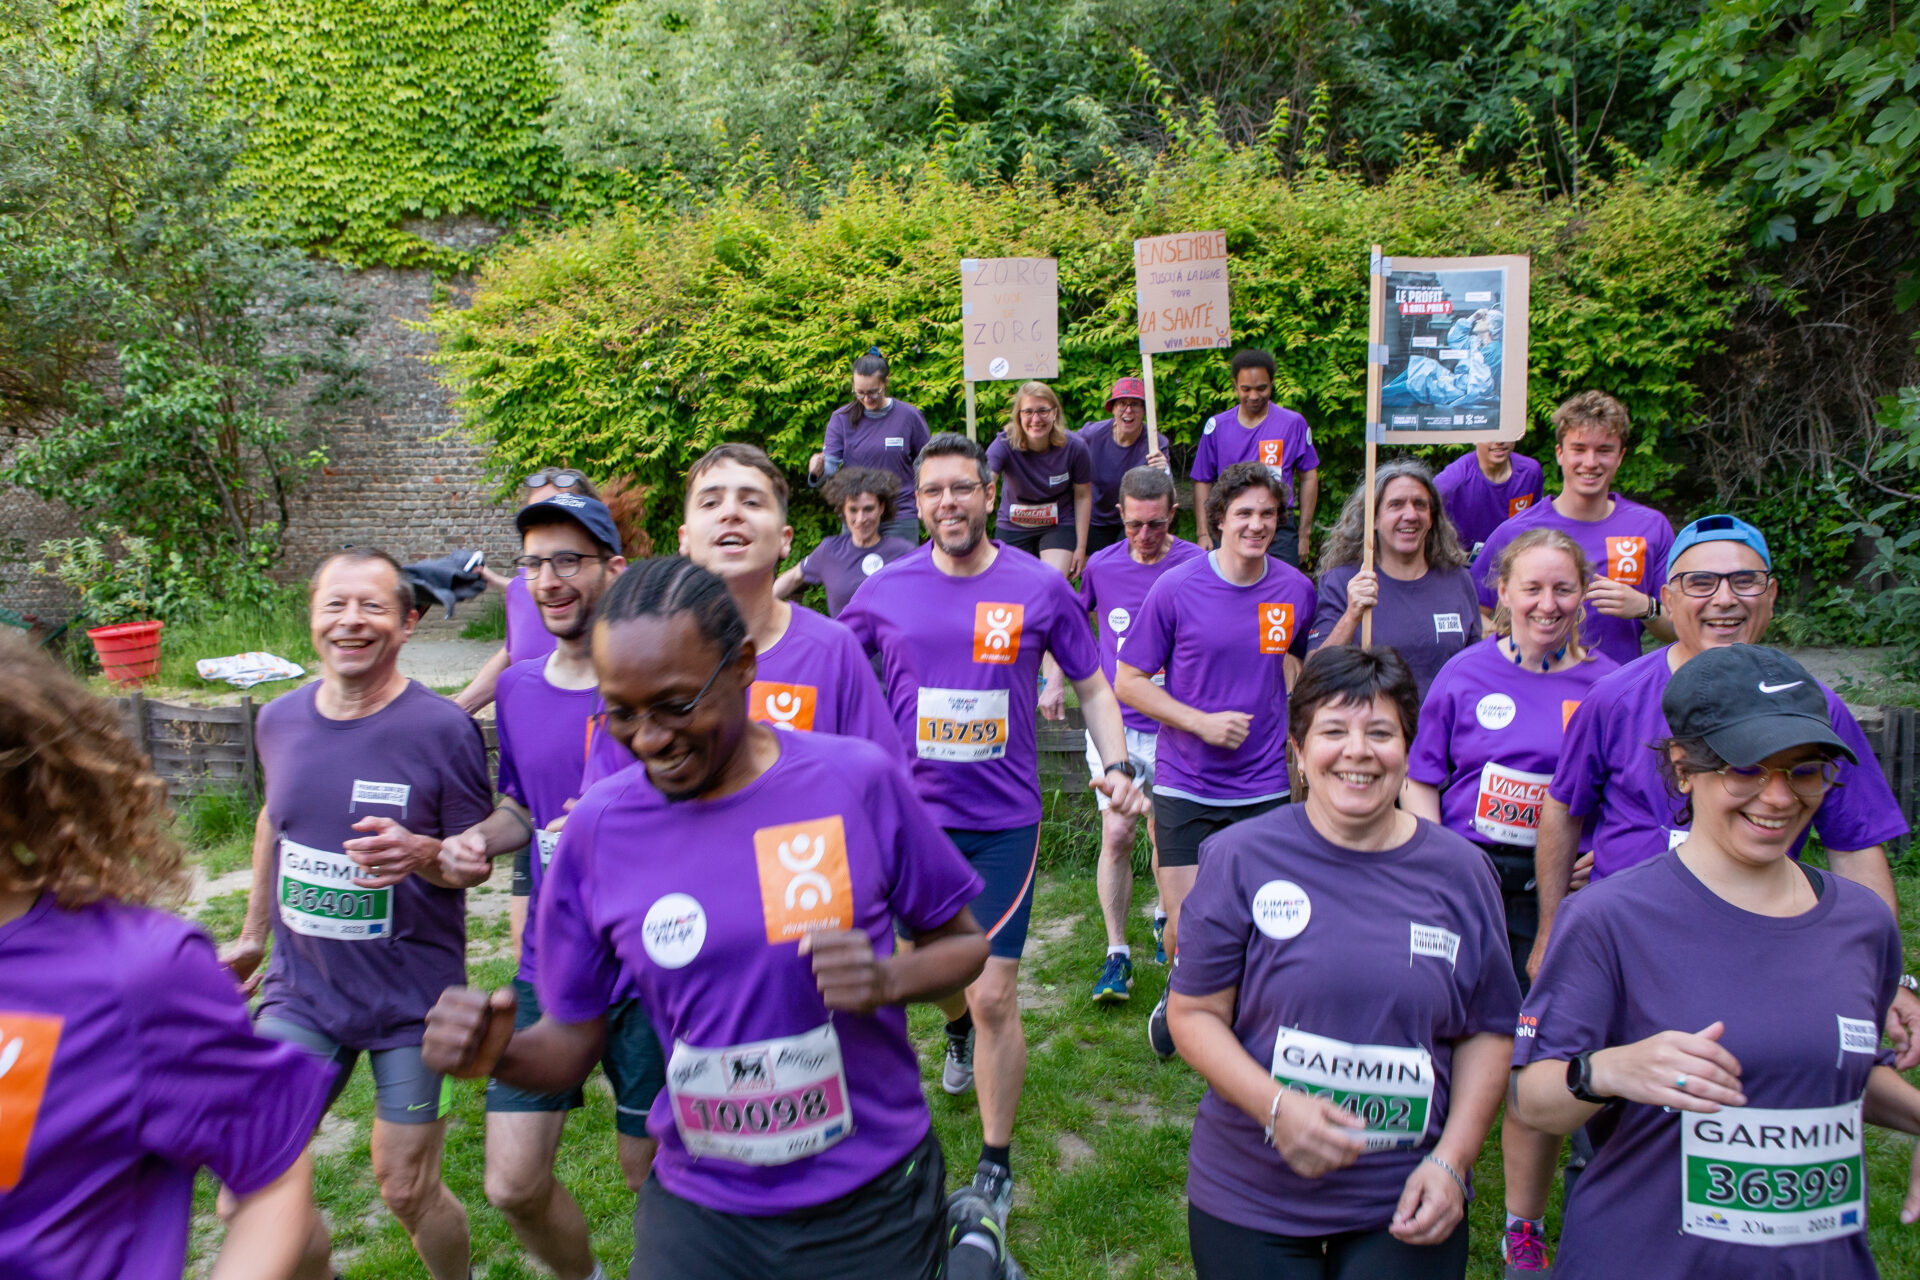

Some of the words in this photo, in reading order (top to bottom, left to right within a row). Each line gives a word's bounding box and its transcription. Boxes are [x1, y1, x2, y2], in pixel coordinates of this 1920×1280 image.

[1140, 233, 1228, 266] ENSEMBLE
[974, 259, 1048, 286] ZORG
[1395, 290, 1406, 303] LE
[1408, 290, 1443, 303] PROFIT
[973, 319, 1042, 345] ZORG
[1139, 311, 1156, 334] LA
[1162, 300, 1214, 331] SANTÉ
[927, 720, 998, 741] 15759
[286, 880, 375, 918] 36401
[1282, 1044, 1421, 1084] GARMIN
[691, 1086, 830, 1136] 10098
[1693, 1117, 1855, 1150] GARMIN
[1705, 1162, 1851, 1210] 36399
